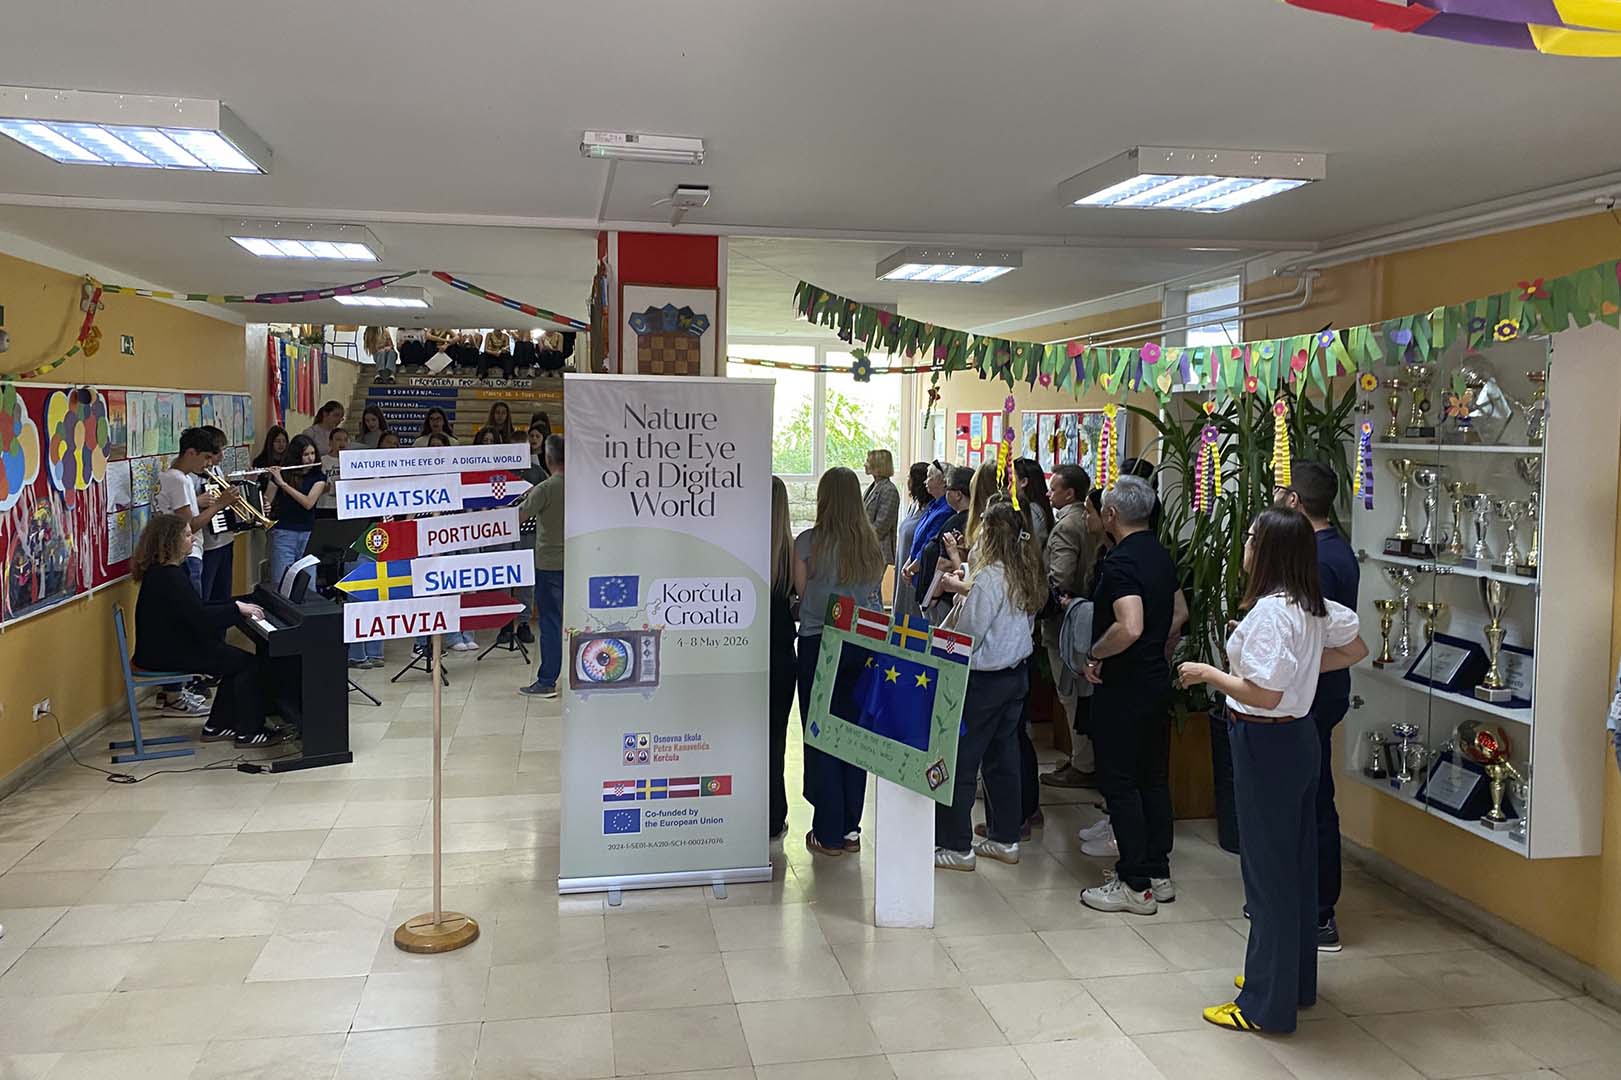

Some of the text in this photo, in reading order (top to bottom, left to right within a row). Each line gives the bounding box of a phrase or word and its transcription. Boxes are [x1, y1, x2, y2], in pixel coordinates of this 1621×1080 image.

[623, 402, 718, 430] Nature
[605, 433, 736, 464] in the Eye
[350, 455, 522, 469] NATURE IN THE EYE OF A DIGITAL WORLD
[602, 461, 744, 495] of a Digital
[345, 488, 451, 510] HRVATSKA
[630, 491, 715, 517] World
[428, 521, 512, 546] PORTUGAL
[425, 564, 522, 592] SWEDEN
[663, 583, 741, 604] Korčula
[355, 611, 447, 638] LATVIA
[664, 605, 739, 625] Croatia
[700, 637, 720, 648] May
[722, 636, 749, 646] 2026
[653, 735, 682, 743] Osnovna
[645, 808, 699, 818] Co-funded by
[660, 819, 698, 827] European
[700, 817, 724, 825] Union
